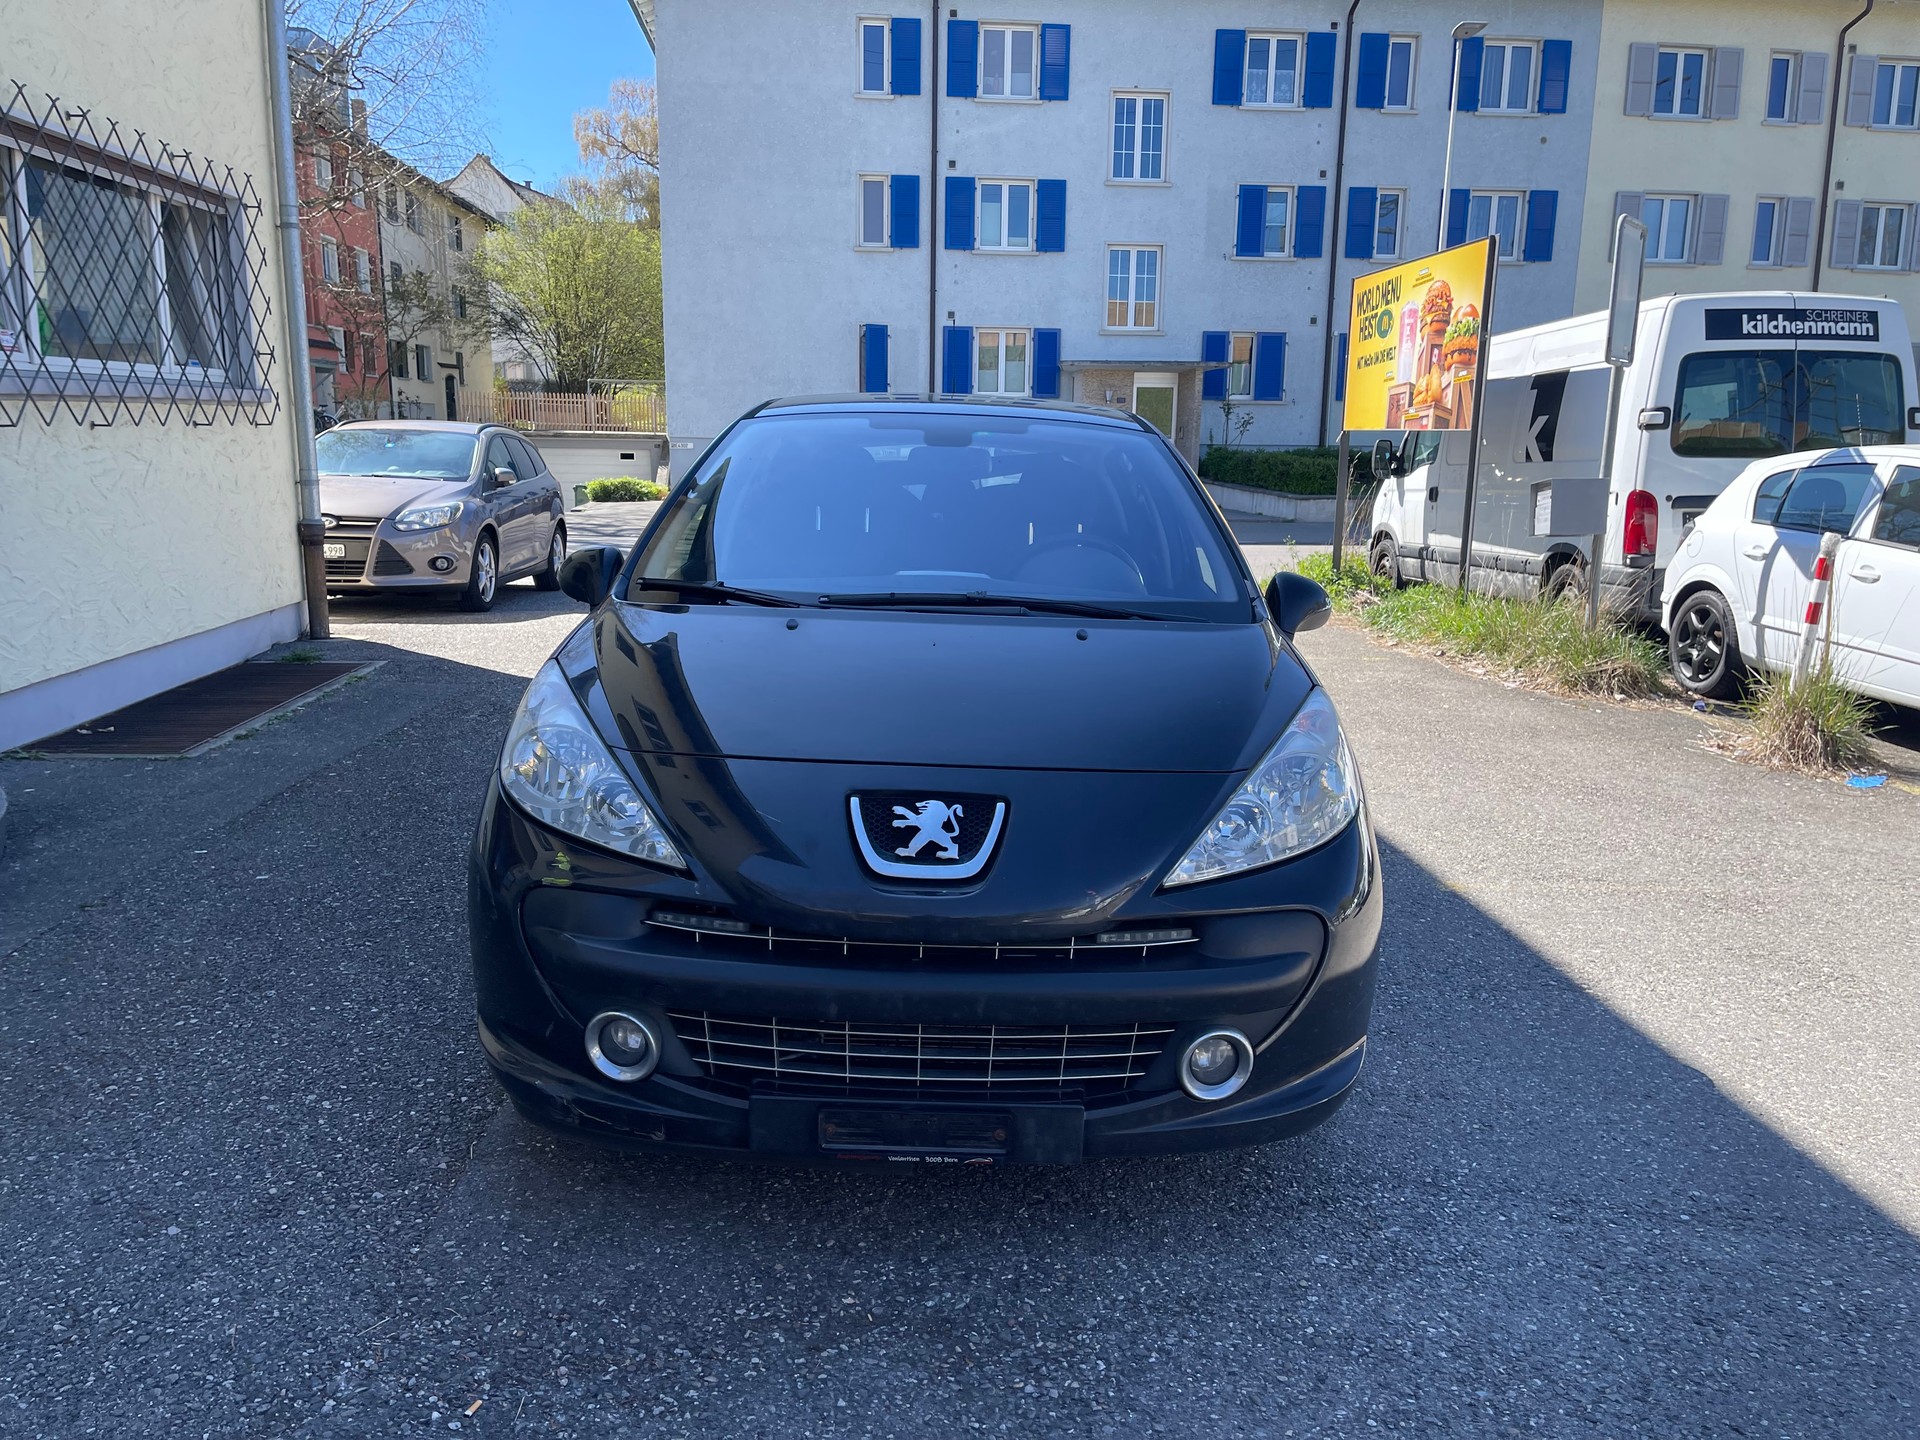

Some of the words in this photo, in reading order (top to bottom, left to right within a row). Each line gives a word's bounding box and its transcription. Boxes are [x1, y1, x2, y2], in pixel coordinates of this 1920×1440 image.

[1356, 284, 1380, 317] WORLD
[1380, 274, 1402, 308] MENU
[1358, 312, 1378, 343] HEIST
[1741, 314, 1874, 336] kilchenmann
[1806, 310, 1869, 322] SCHREINER
